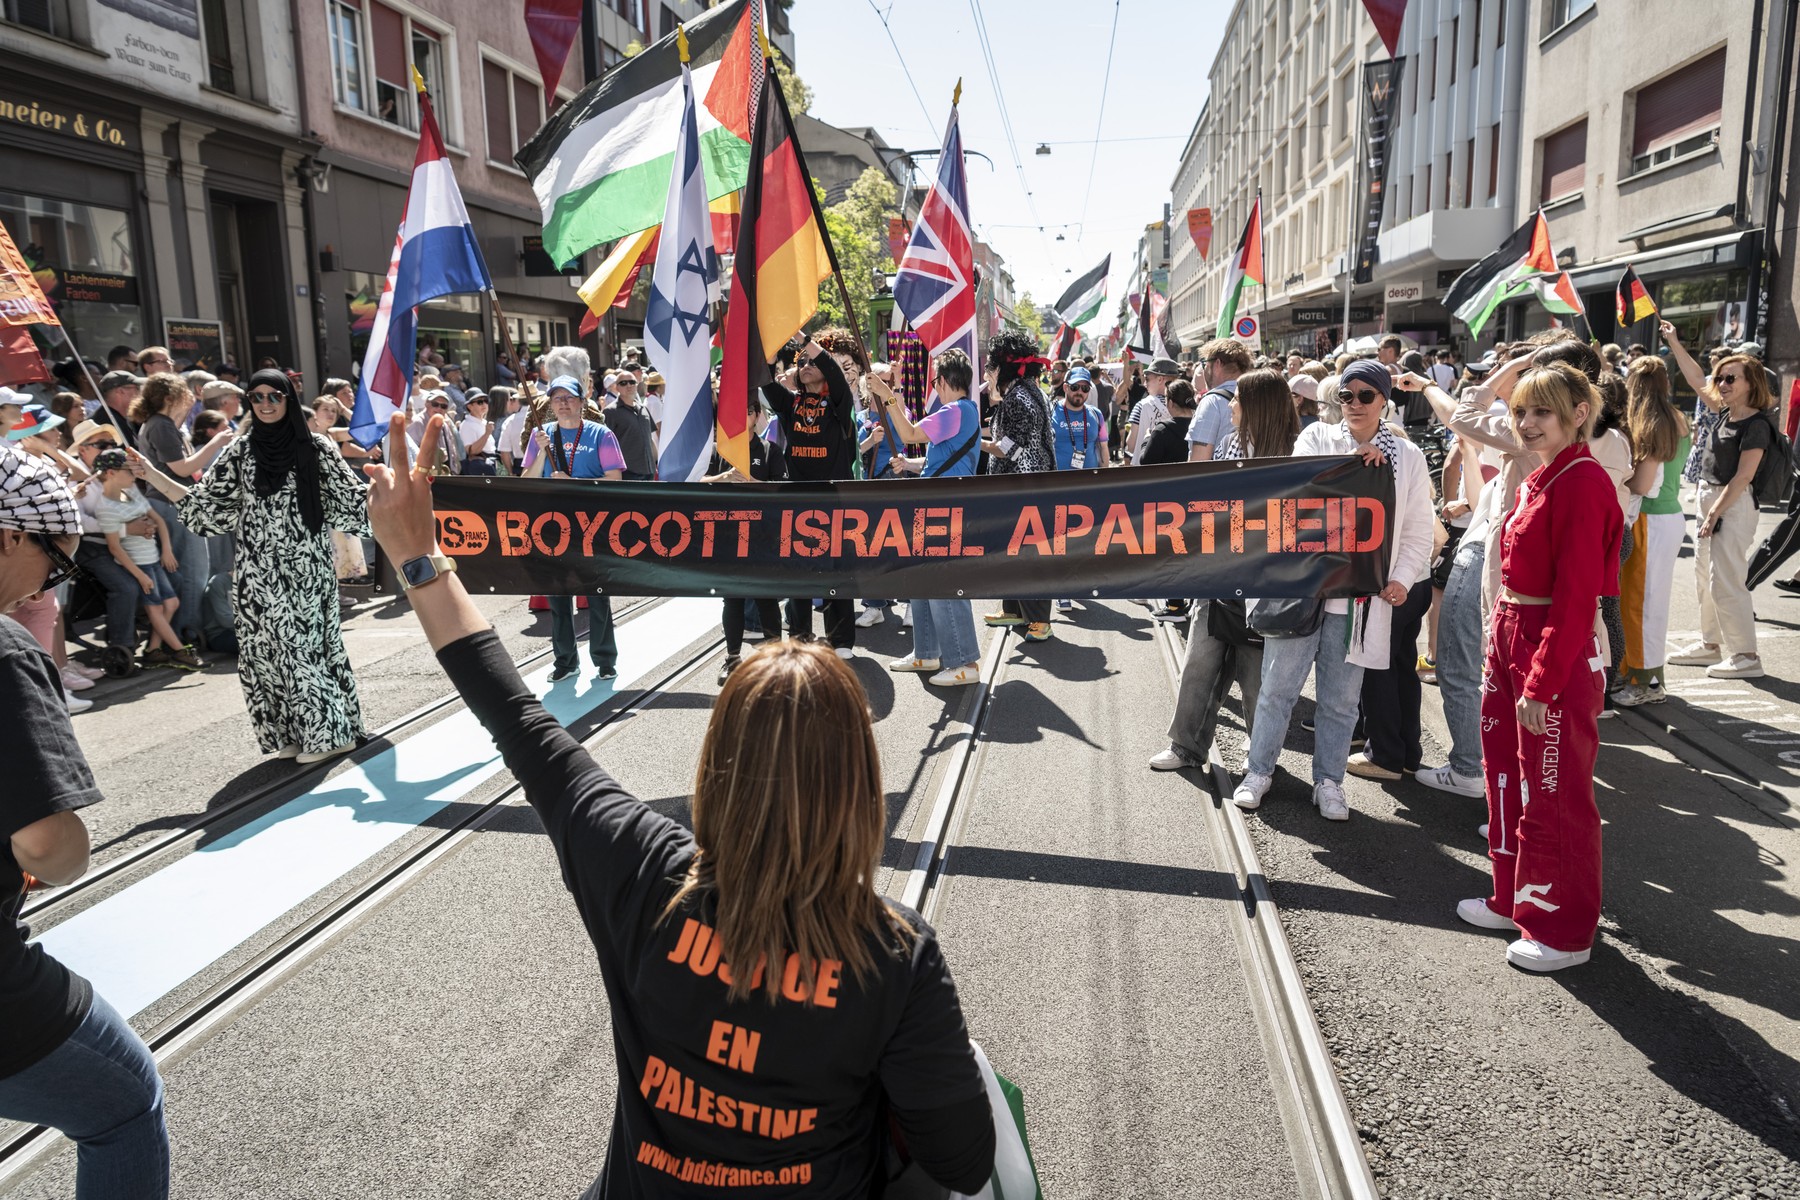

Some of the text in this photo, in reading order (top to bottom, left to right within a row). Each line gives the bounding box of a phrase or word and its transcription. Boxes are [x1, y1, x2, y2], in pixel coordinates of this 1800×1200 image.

[73, 113, 88, 137] &
[95, 119, 126, 146] Co.
[63, 272, 126, 288] Lachenmeier
[65, 287, 101, 300] Farben
[1388, 287, 1419, 299] design
[1297, 312, 1326, 320] HOTEL
[168, 325, 219, 337] Lachenmeier
[169, 338, 198, 350] Farben
[791, 446, 828, 458] APARTHEID
[496, 497, 1386, 557] BOYCOTT ISRAEL APARTHEID
[465, 531, 488, 541] FRANCE
[1541, 709, 1562, 793] WASTED LOVE
[667, 917, 843, 1008] JUCE
[706, 1019, 762, 1074] EN
[639, 1055, 818, 1141] PALESTINE
[636, 1141, 812, 1187] www.bdsfrance.org
